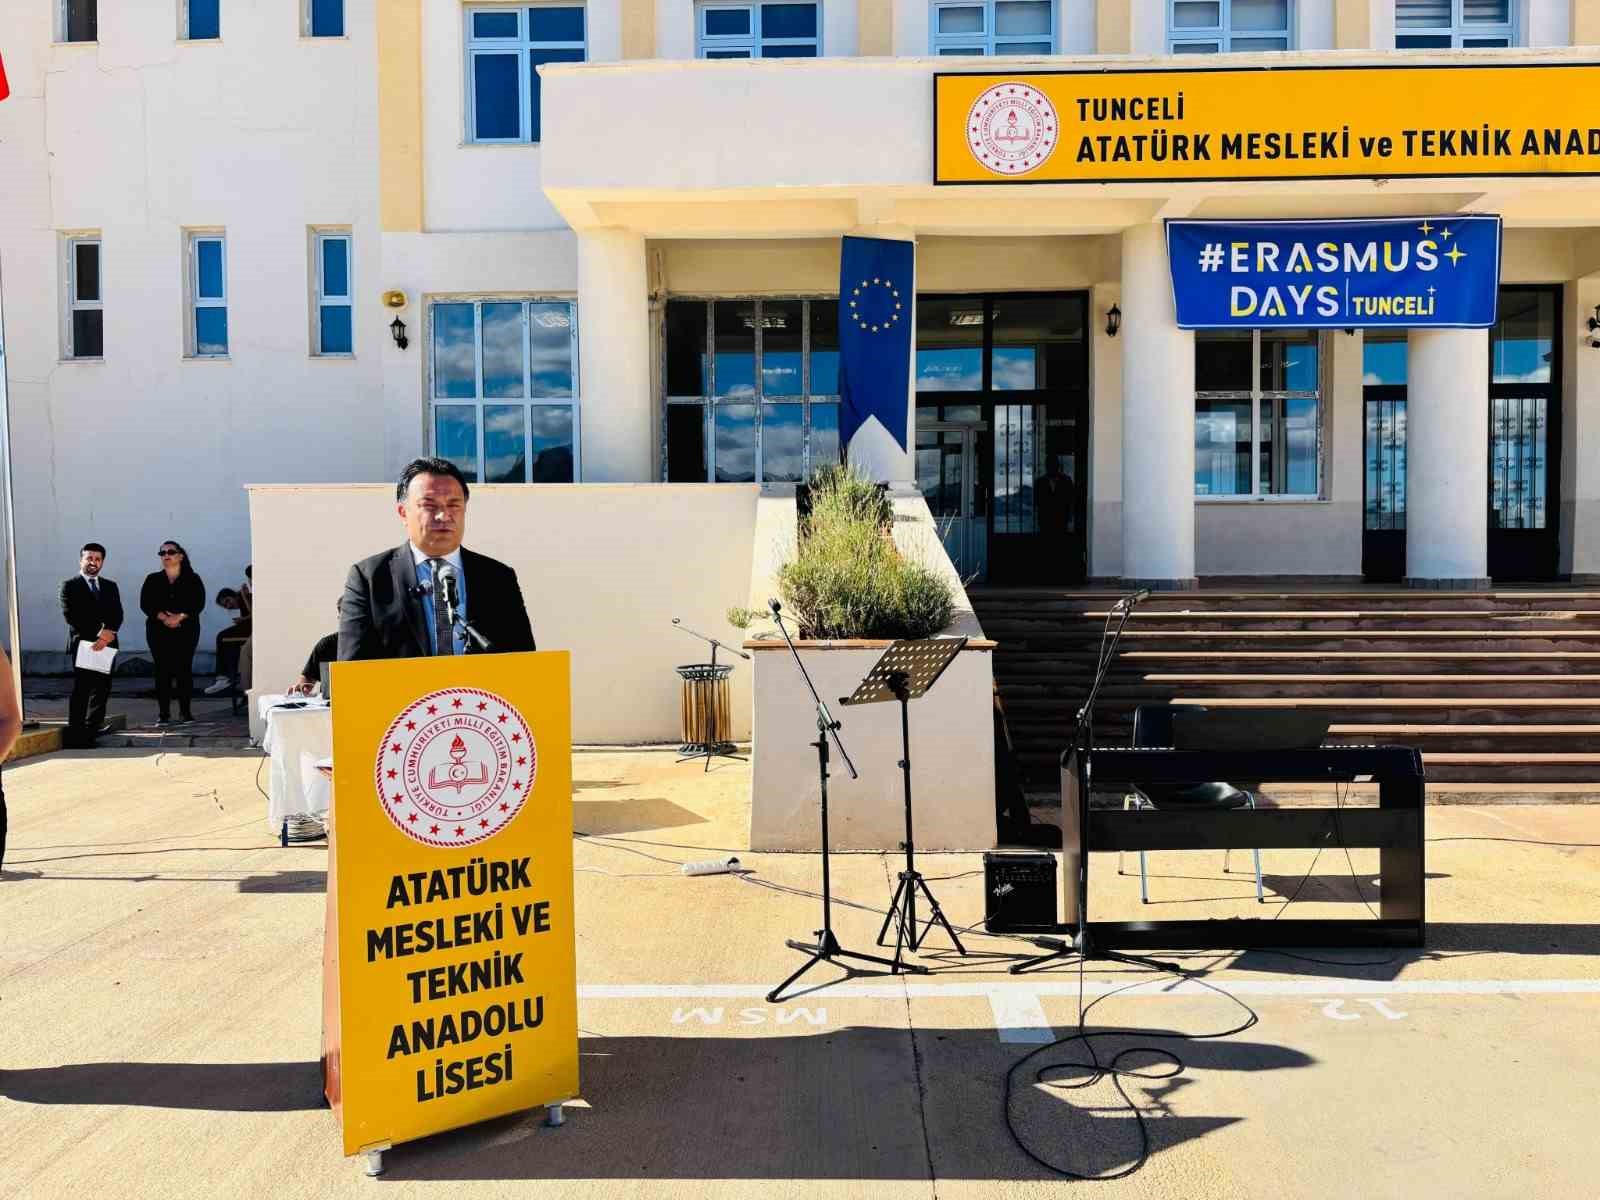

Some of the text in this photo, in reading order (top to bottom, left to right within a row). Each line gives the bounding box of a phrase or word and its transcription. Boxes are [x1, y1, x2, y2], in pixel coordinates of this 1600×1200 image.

[1076, 91, 1184, 121] TUNCELİ
[1076, 129, 1211, 162] ATATÜRK
[1221, 125, 1349, 160] MESLEKİ
[1359, 137, 1393, 157] ve
[1402, 123, 1511, 157] TEKNİK
[1199, 240, 1438, 273] #ERASMUS
[1230, 285, 1339, 317] DAYS
[387, 858, 532, 909] ATATÜRK
[367, 902, 550, 962] MESLEKİ VE
[408, 951, 523, 1003] TEKNİK
[388, 997, 544, 1059] ANADOLU
[418, 1044, 513, 1102] LİSESİ
